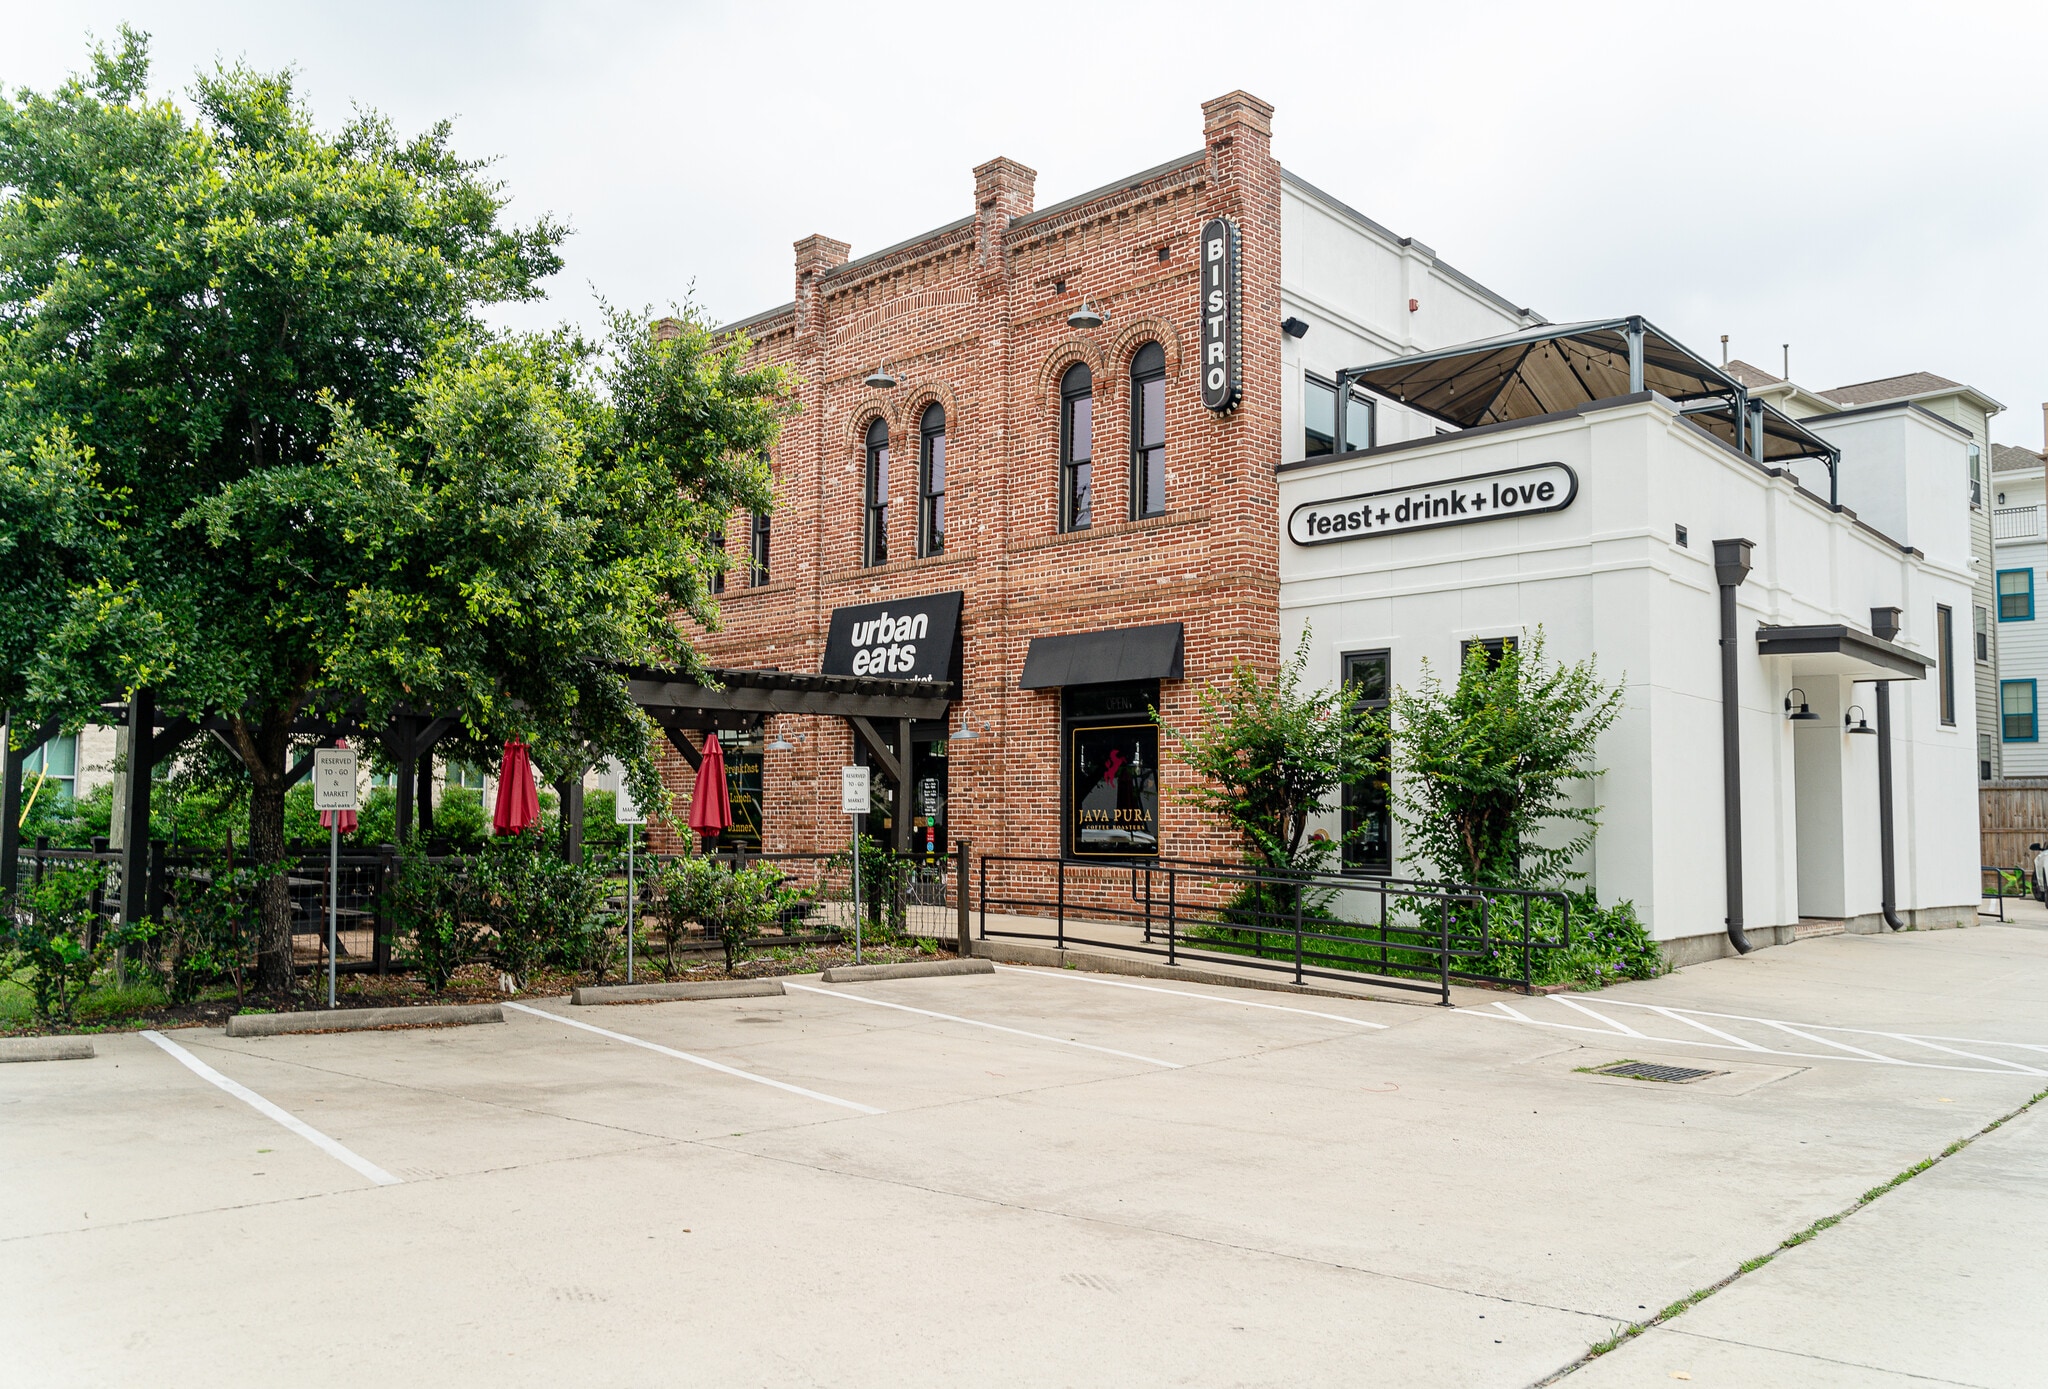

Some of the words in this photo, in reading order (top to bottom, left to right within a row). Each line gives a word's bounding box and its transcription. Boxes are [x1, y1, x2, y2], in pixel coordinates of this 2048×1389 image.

[1207, 238, 1225, 391] BISTRO
[851, 612, 928, 647] urban
[852, 643, 916, 676] eats
[729, 792, 752, 803] Lunch
[727, 823, 753, 833] Dinner
[1078, 809, 1110, 825] JAVA
[1113, 808, 1153, 822] PURA
